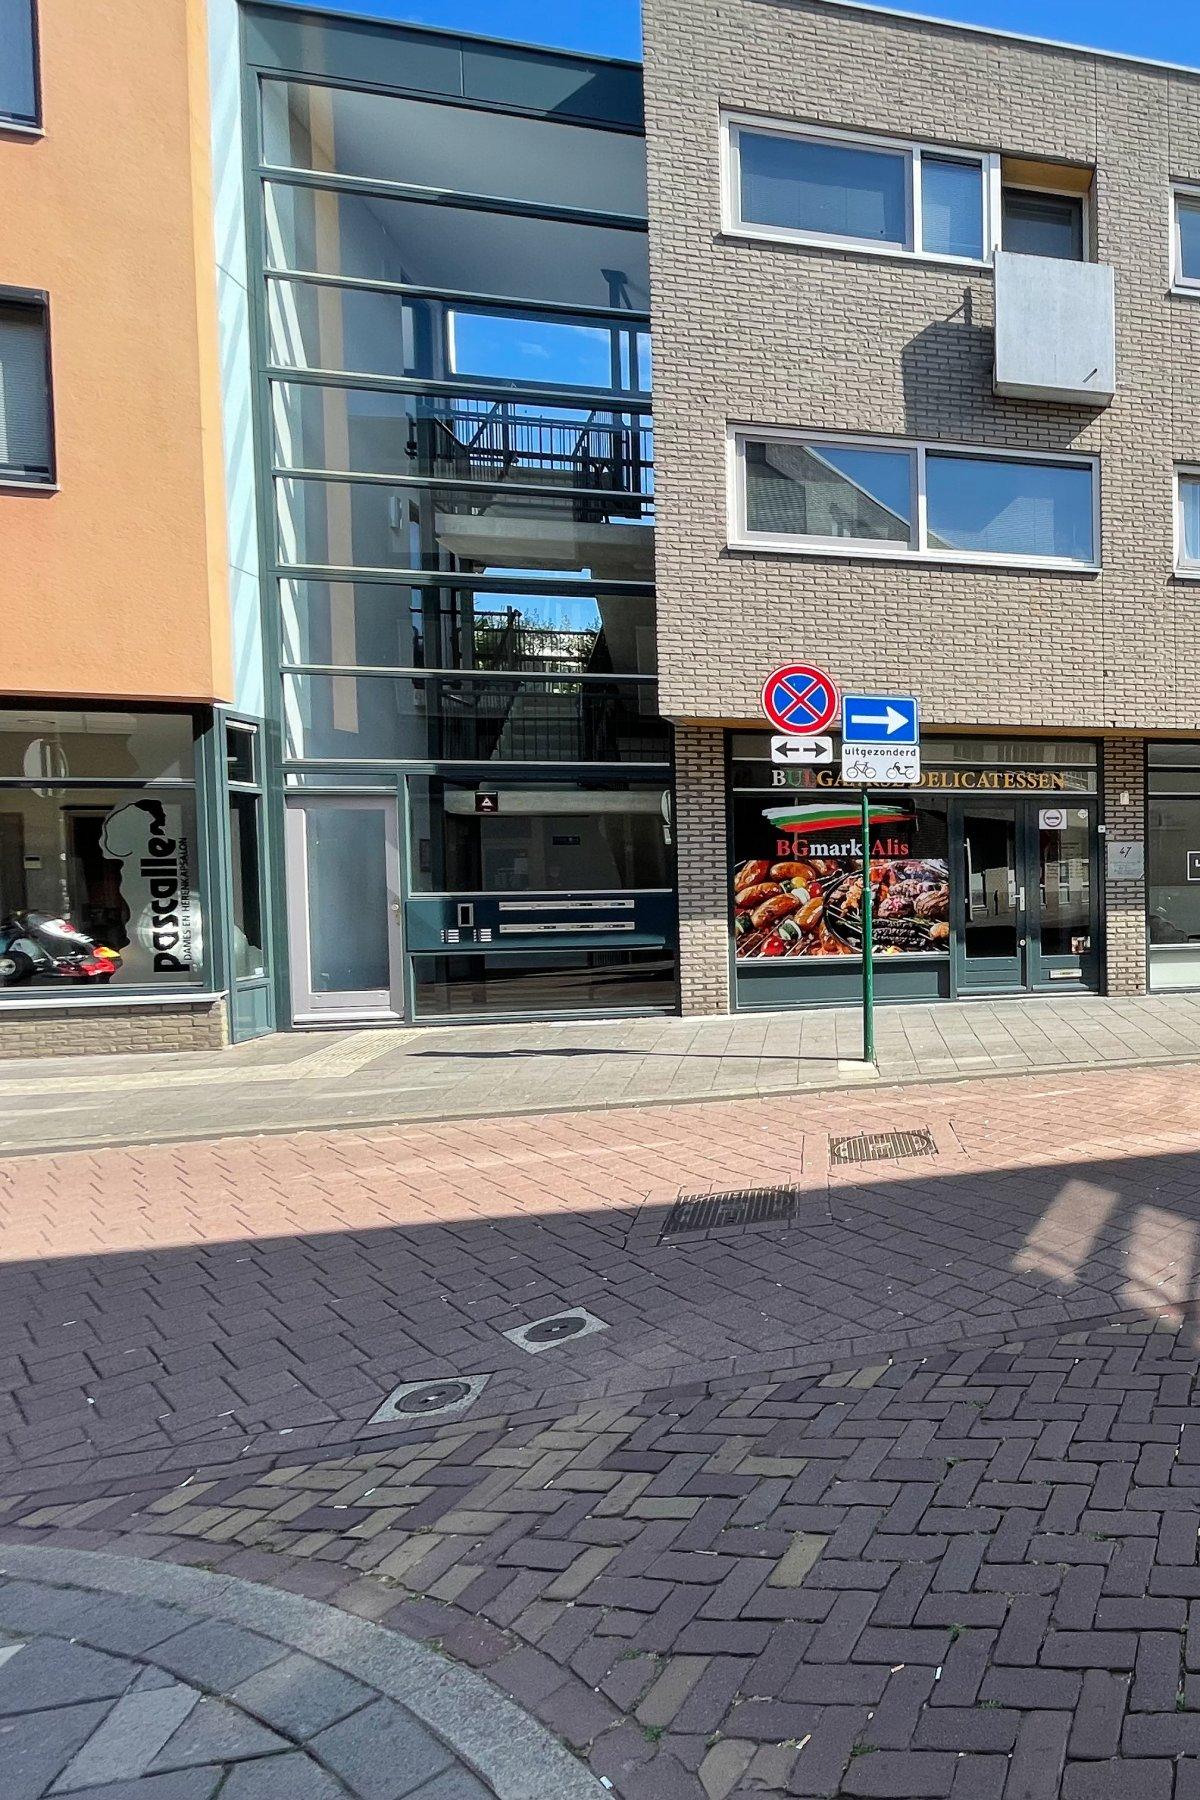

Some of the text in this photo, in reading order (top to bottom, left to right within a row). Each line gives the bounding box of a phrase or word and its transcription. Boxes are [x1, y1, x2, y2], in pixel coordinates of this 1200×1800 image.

[844, 748, 917, 758] uitgezonderd
[910, 770, 1067, 790] DELICATESSEN
[140, 837, 191, 973] pascalle
[178, 837, 193, 961] DAMES EN HERENKAPSALON
